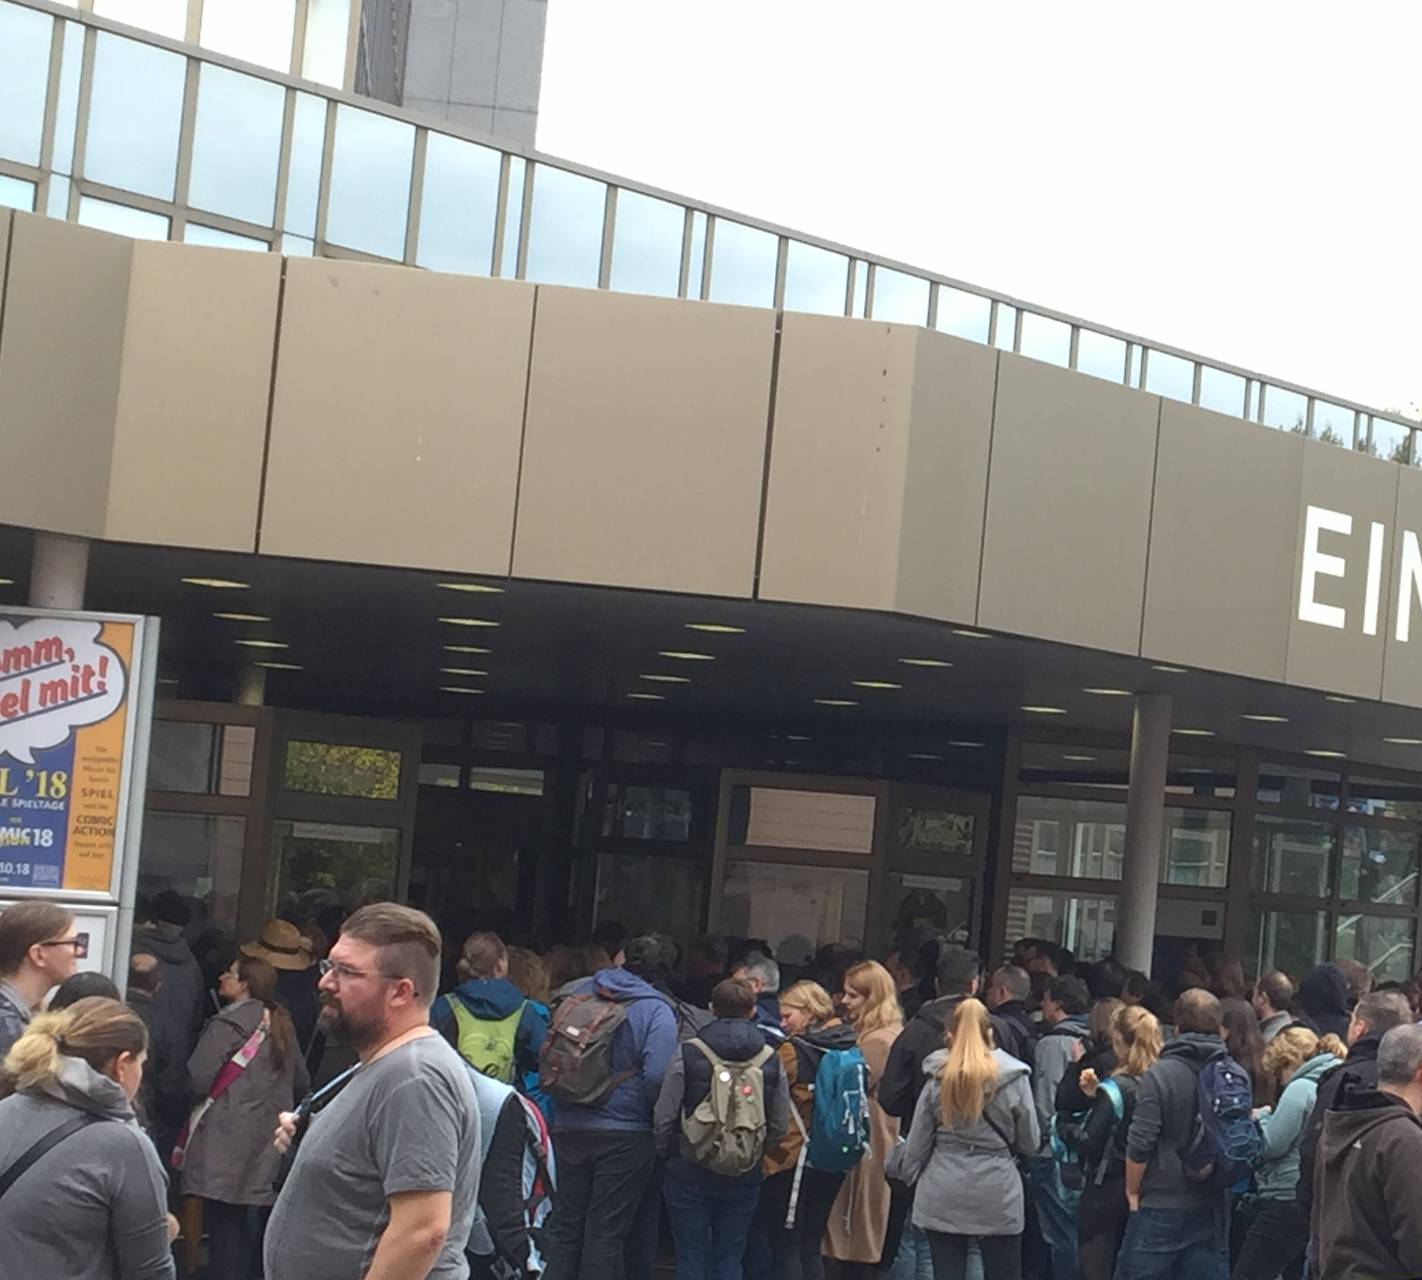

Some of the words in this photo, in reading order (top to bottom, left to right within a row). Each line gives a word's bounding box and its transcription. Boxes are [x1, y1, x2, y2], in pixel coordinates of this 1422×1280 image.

[0, 636, 75, 675] mm,
[39, 655, 109, 707] mit!
[81, 787, 114, 799] SPIEL
[76, 813, 114, 826] COMIC
[72, 825, 116, 838] ACTION
